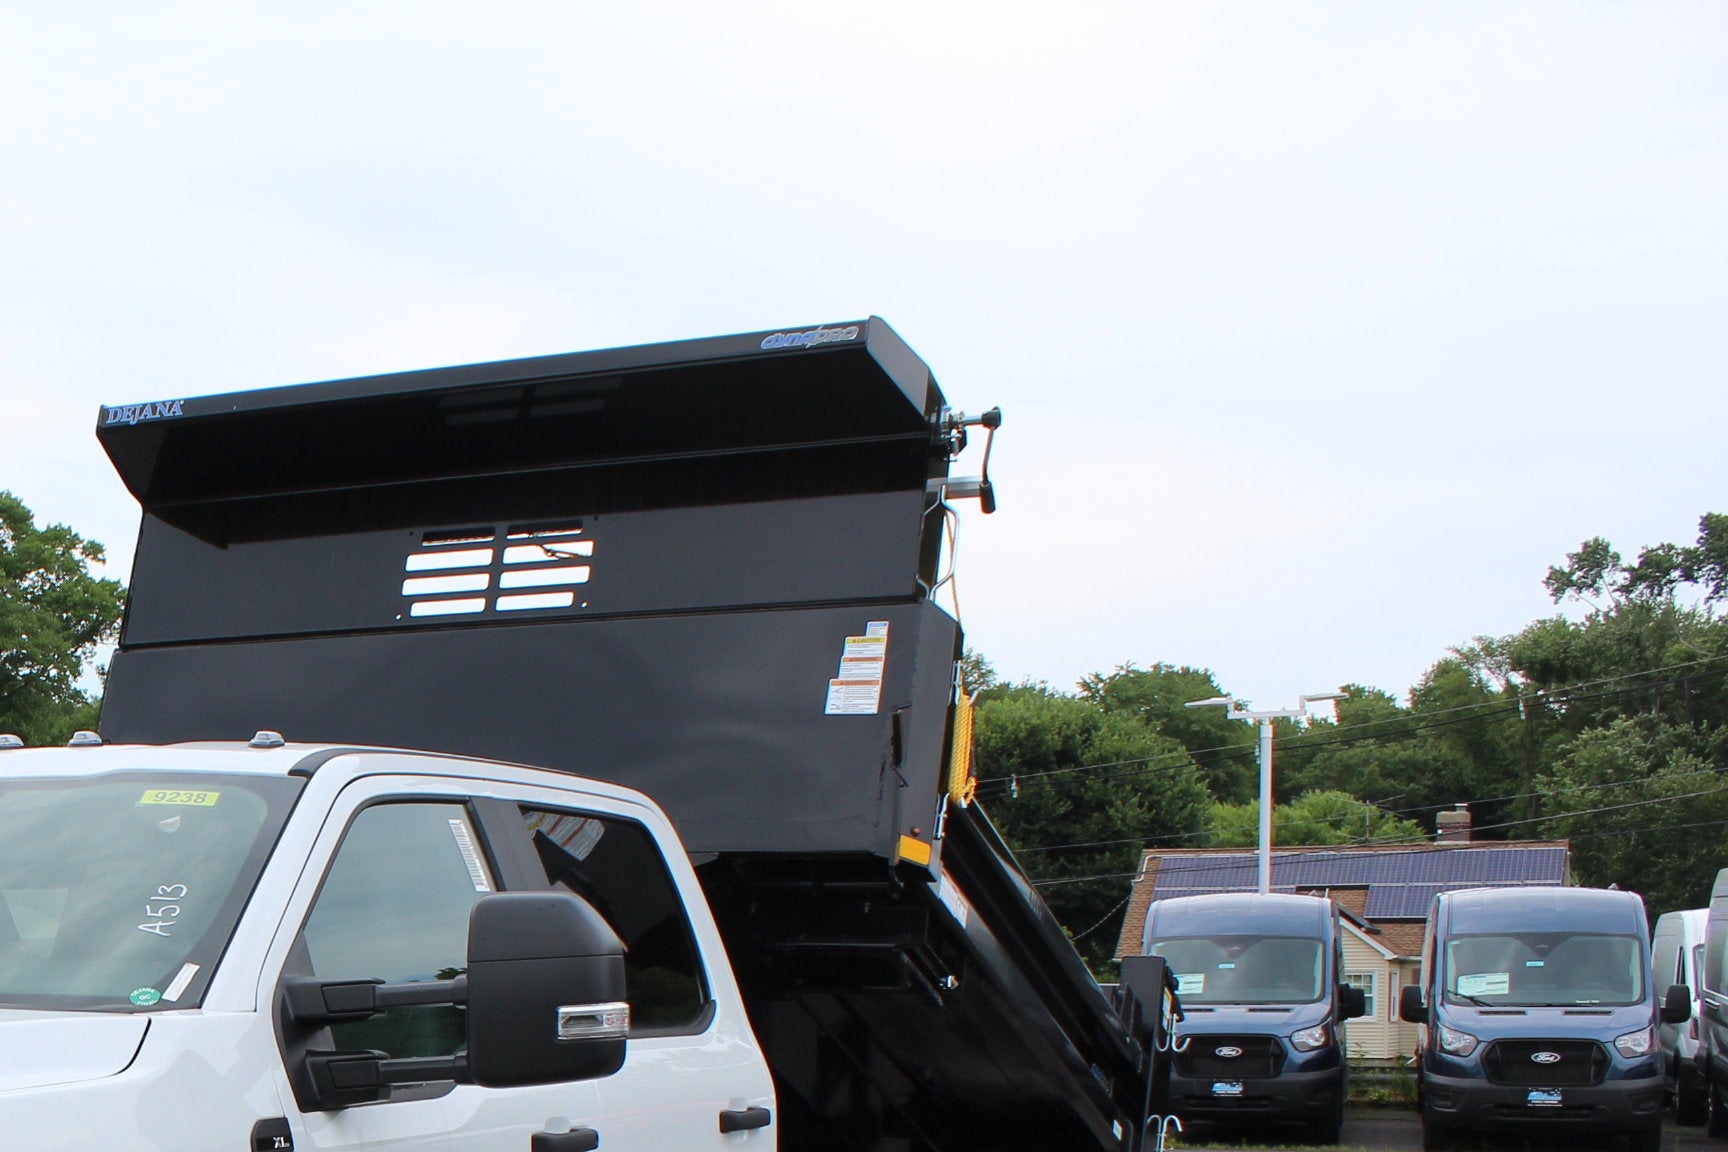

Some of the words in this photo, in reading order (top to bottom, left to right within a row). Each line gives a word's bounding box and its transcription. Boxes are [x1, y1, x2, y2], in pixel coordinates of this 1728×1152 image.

[106, 400, 183, 425] DEJANA
[153, 791, 208, 804] 9238
[137, 883, 188, 937] A513
[272, 1136, 290, 1149] XL
